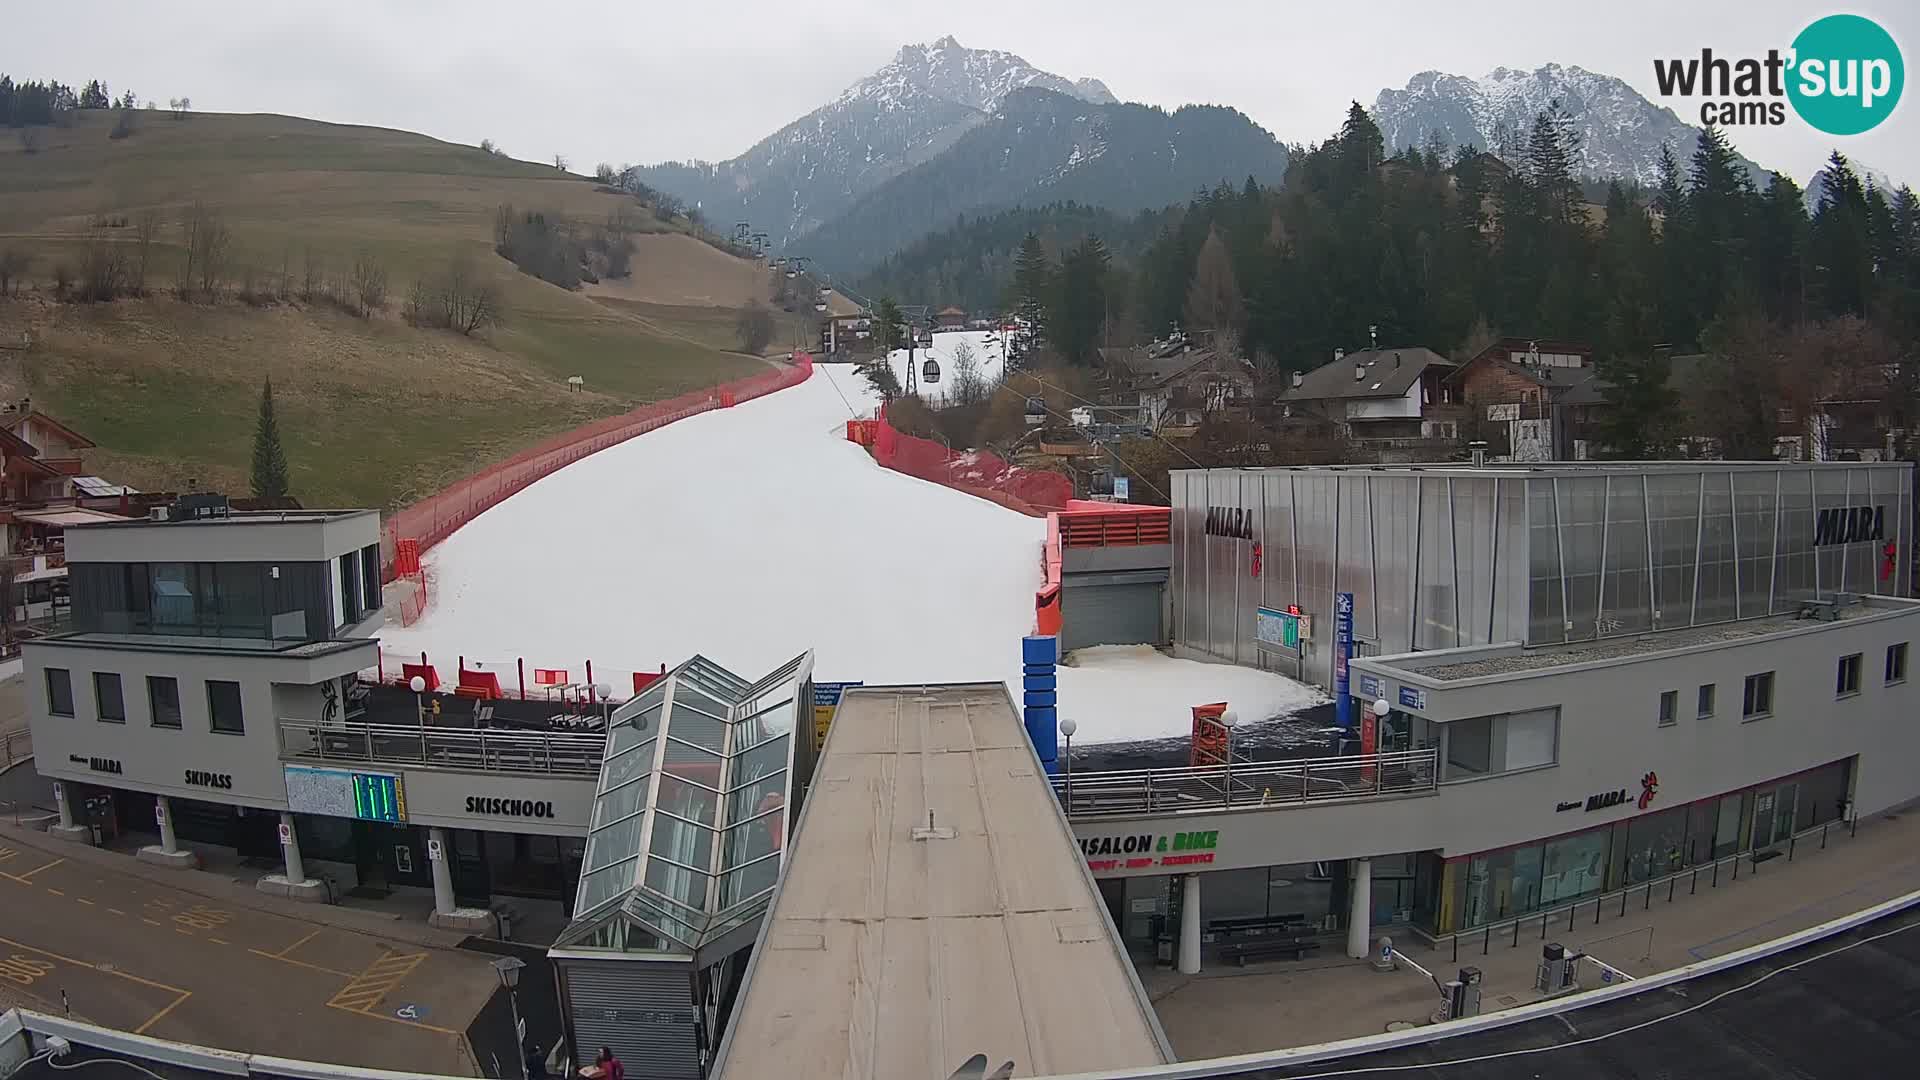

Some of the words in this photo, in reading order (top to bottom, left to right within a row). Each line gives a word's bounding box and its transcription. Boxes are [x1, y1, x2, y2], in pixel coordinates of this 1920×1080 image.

[1205, 506, 1253, 540] MIARA
[1813, 505, 1884, 546] MIARA
[90, 756, 122, 775] MIARA
[184, 769, 232, 789] SKIPASS
[465, 796, 555, 818] SKISCHOOL
[1585, 789, 1626, 812] MIARA
[1077, 835, 1152, 856] ISALON
[1156, 836, 1168, 852] &
[1173, 831, 1219, 850] BIKE
